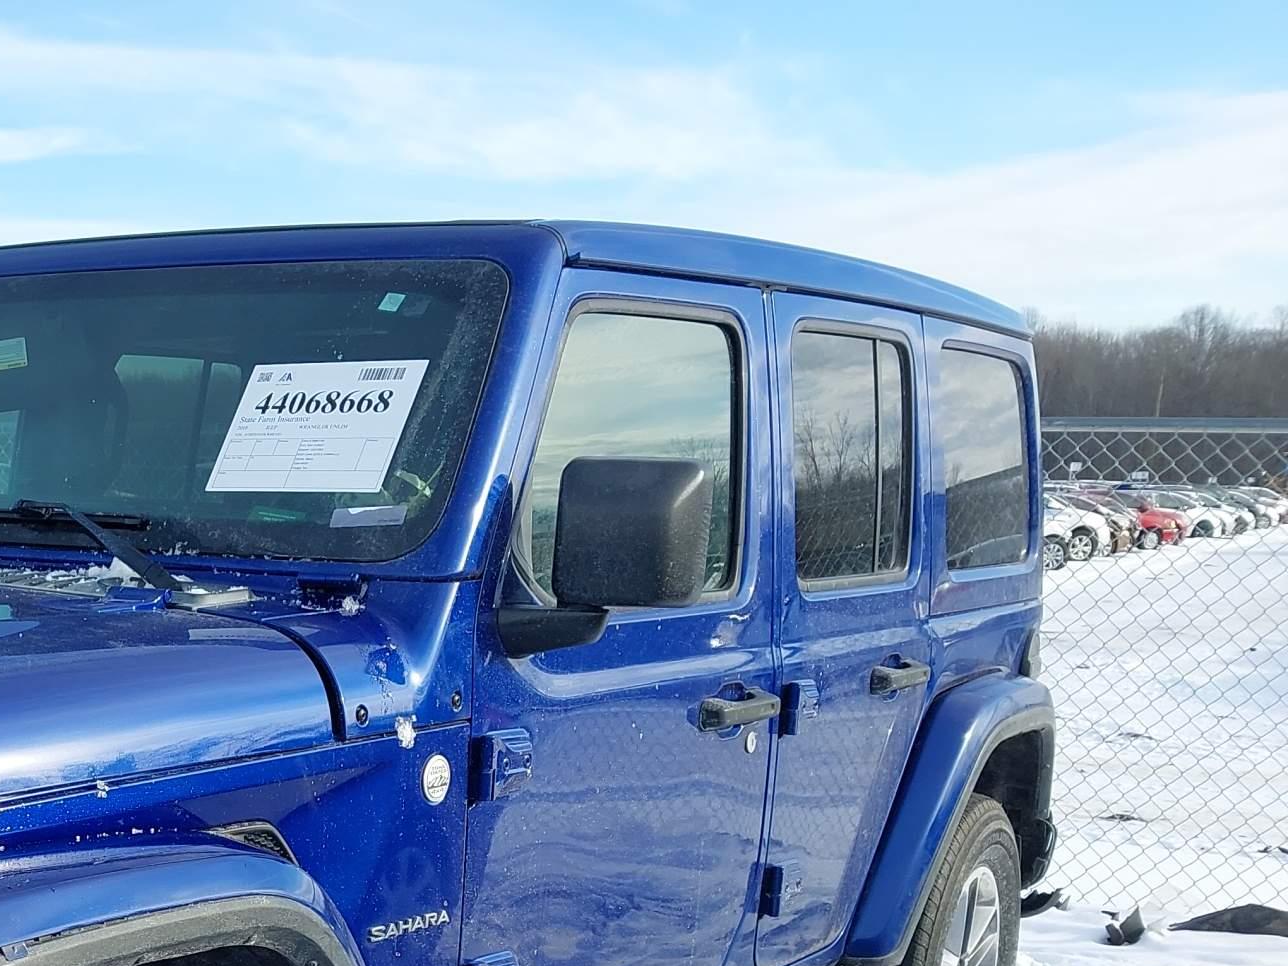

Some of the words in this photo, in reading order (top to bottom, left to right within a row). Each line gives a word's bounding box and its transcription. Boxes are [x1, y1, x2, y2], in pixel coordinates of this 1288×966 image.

[255, 389, 394, 415] 44068668
[240, 416, 257, 424] State
[277, 415, 311, 423] Insurance
[369, 910, 450, 942] SAHARA
